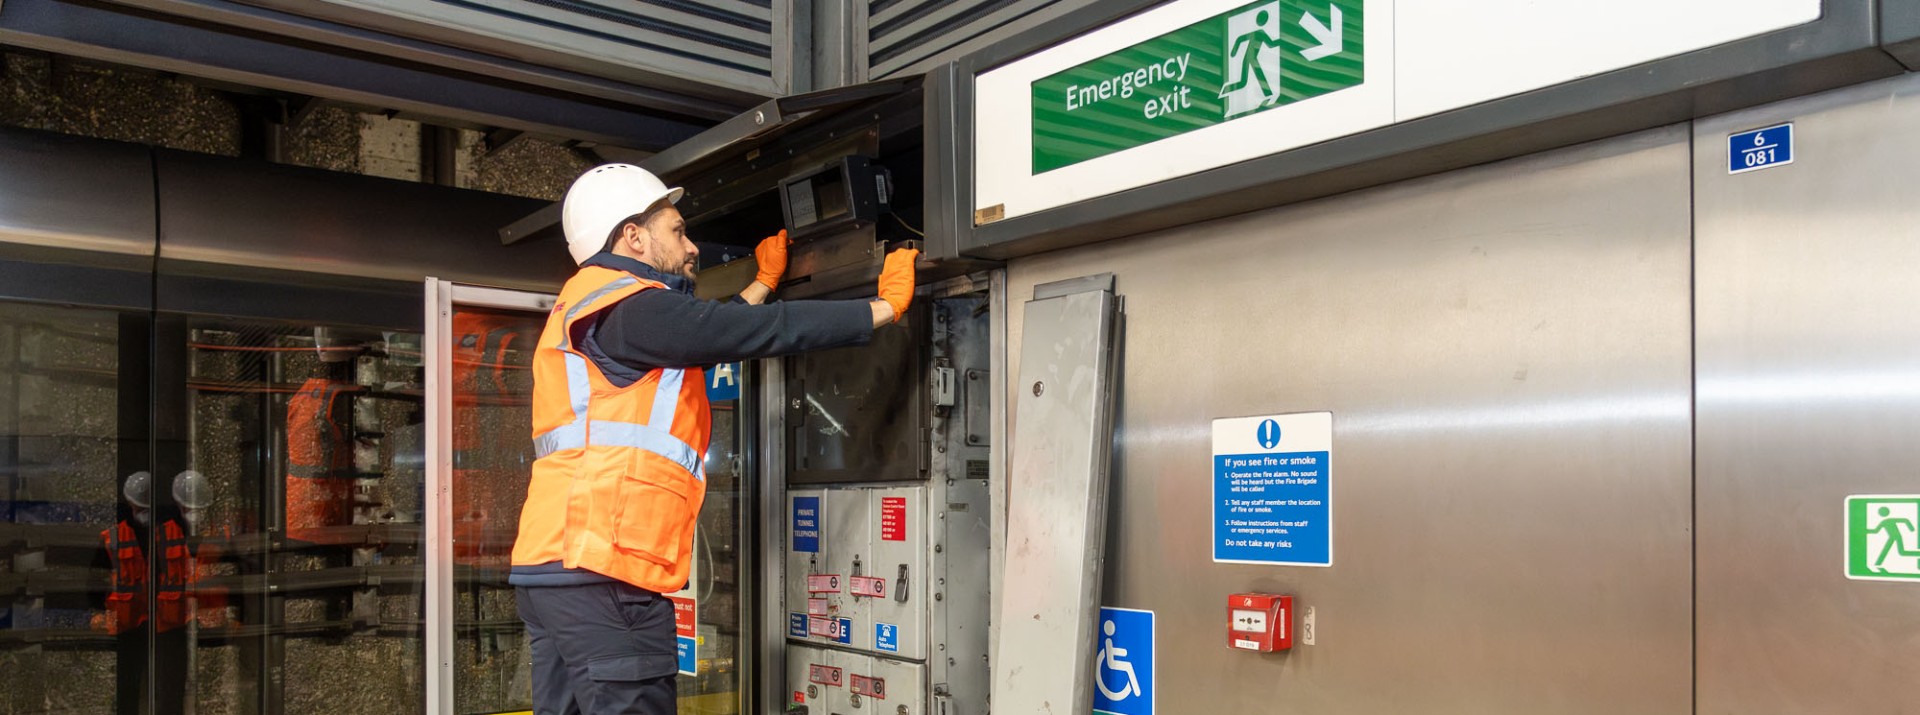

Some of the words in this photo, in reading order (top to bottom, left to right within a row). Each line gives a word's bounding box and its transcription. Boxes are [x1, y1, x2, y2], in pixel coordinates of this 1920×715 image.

[1067, 52, 1191, 111] Emergency
[1144, 85, 1191, 119] exit
[1754, 132, 1765, 146] 6
[1745, 148, 1775, 167] 081
[1225, 458, 1232, 467] If
[1264, 457, 1277, 466] fire
[1290, 456, 1317, 465] smoke
[1297, 478, 1317, 486] Brigade
[797, 509, 814, 517] PRIVATE
[797, 519, 814, 527] TUNNEL
[794, 530, 818, 538] TELEPHONE
[1263, 541, 1275, 549] any
